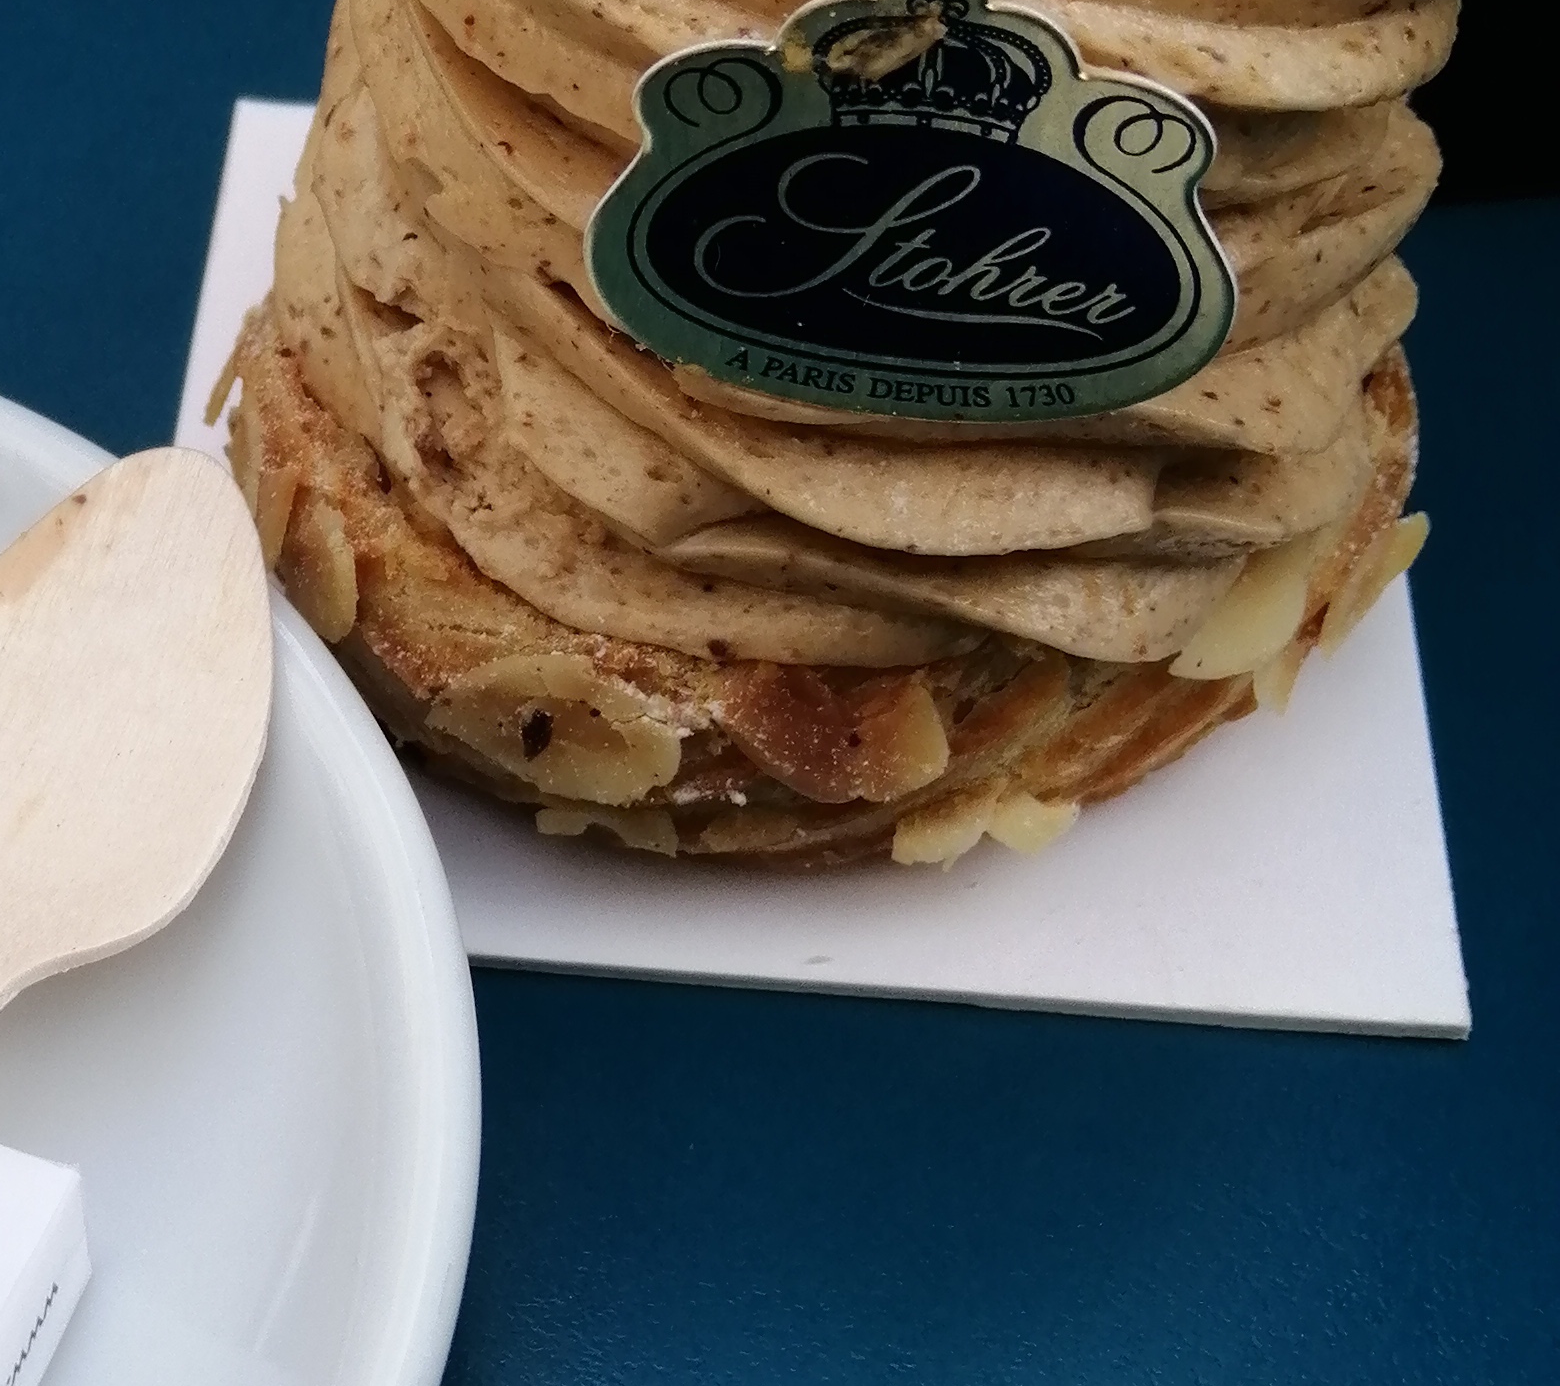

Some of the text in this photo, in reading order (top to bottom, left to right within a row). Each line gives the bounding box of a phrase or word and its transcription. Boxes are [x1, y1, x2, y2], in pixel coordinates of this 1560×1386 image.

[694, 152, 1136, 325] Stohrer
[759, 357, 856, 394] PARIS
[867, 376, 990, 408] DEPUIS
[1005, 383, 1076, 409] 1730
